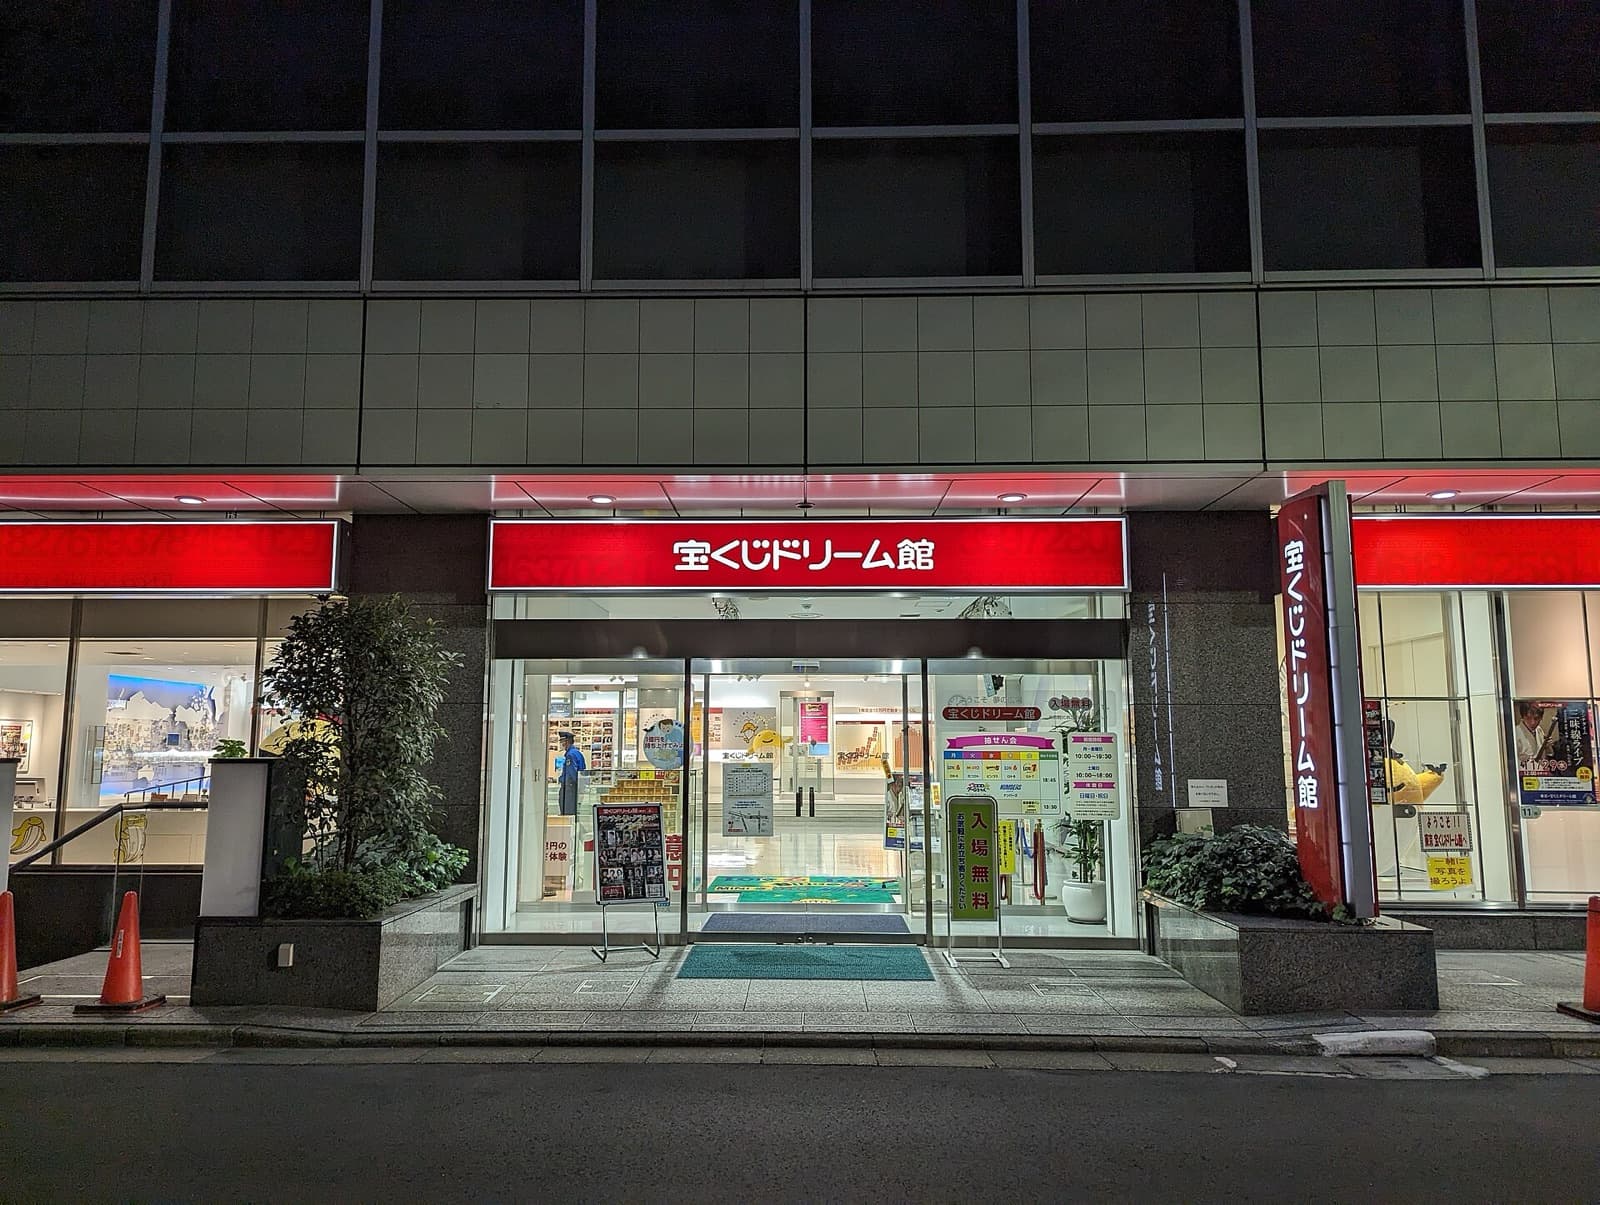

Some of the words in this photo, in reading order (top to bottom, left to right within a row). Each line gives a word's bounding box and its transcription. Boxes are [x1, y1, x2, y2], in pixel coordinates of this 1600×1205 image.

[673, 539, 935, 571] 宝くじドリーム館
[1284, 540, 1318, 809] 宝くじドリーム館
[948, 708, 1035, 719] 宝くじドリーム館
[1567, 709, 1584, 766] 三味線ライブ
[957, 813, 966, 910] お気軽にお立ち寄りください
[971, 812, 989, 910] 入場無料
[1435, 867, 1466, 875] 写真を
